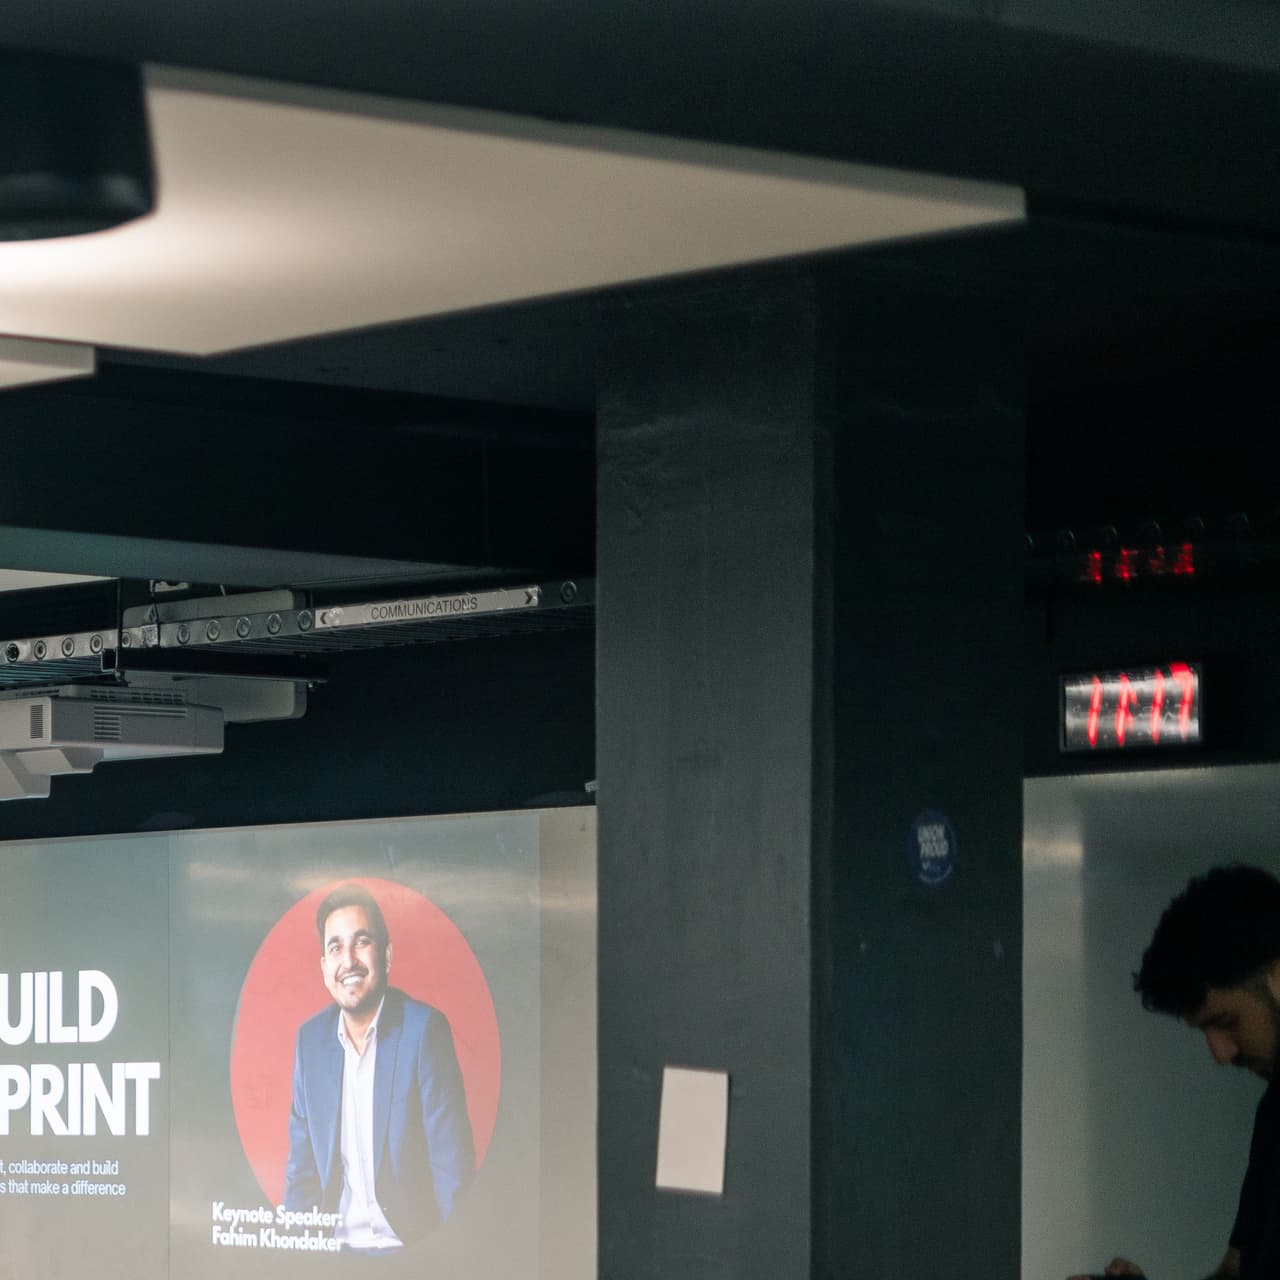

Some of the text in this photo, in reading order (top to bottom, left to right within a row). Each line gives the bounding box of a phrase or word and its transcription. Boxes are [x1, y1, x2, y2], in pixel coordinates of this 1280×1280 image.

[370, 597, 479, 620] COMMUNICATIONS
[8, 1160, 68, 1175] collaborate
[70, 1160, 90, 1176] and
[92, 1160, 120, 1176] build
[8, 1180, 29, 1194] that
[30, 1181, 60, 1195] make
[61, 1183, 70, 1195] a
[71, 1181, 127, 1196] difference
[212, 1201, 344, 1230] Keynote Speaker:
[212, 1225, 345, 1251] Fahim Khondaker
